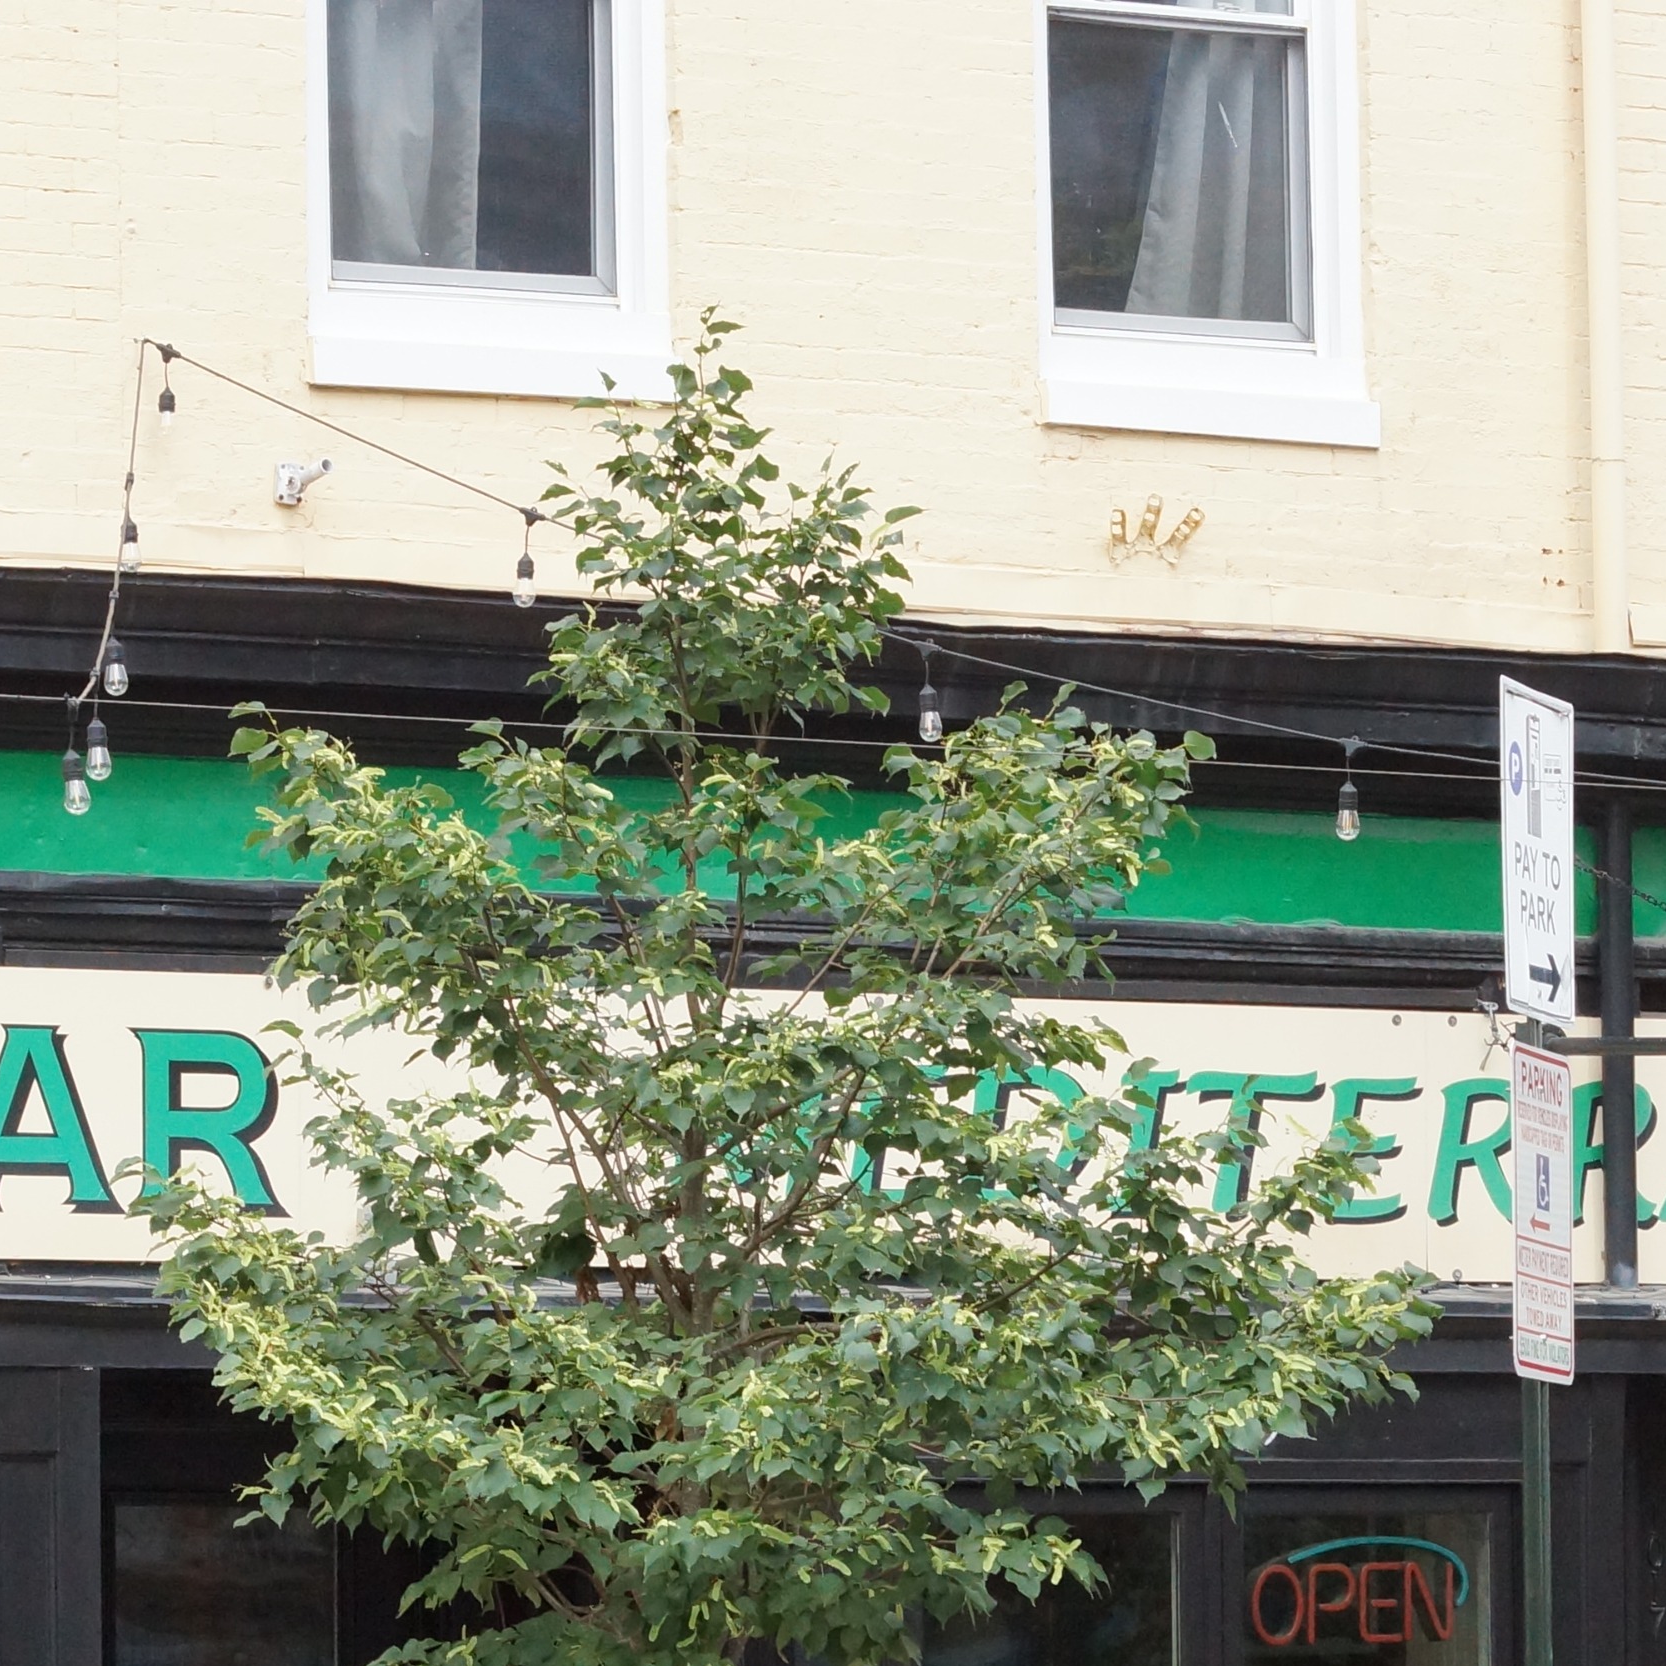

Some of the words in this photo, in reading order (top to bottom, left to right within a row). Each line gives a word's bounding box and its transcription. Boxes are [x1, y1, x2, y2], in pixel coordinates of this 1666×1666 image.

[1514, 841, 1539, 882] PAY
[1542, 851, 1562, 891] TO
[1520, 889, 1557, 936] PARK
[1521, 1059, 1562, 1108] PARKING
[1520, 1280, 1537, 1301] OTHER
[1540, 1285, 1566, 1309] VEHICLES
[1526, 1306, 1544, 1327] TOWED
[1544, 1311, 1561, 1331] AWAY
[1251, 1561, 1455, 1647] OPEN
